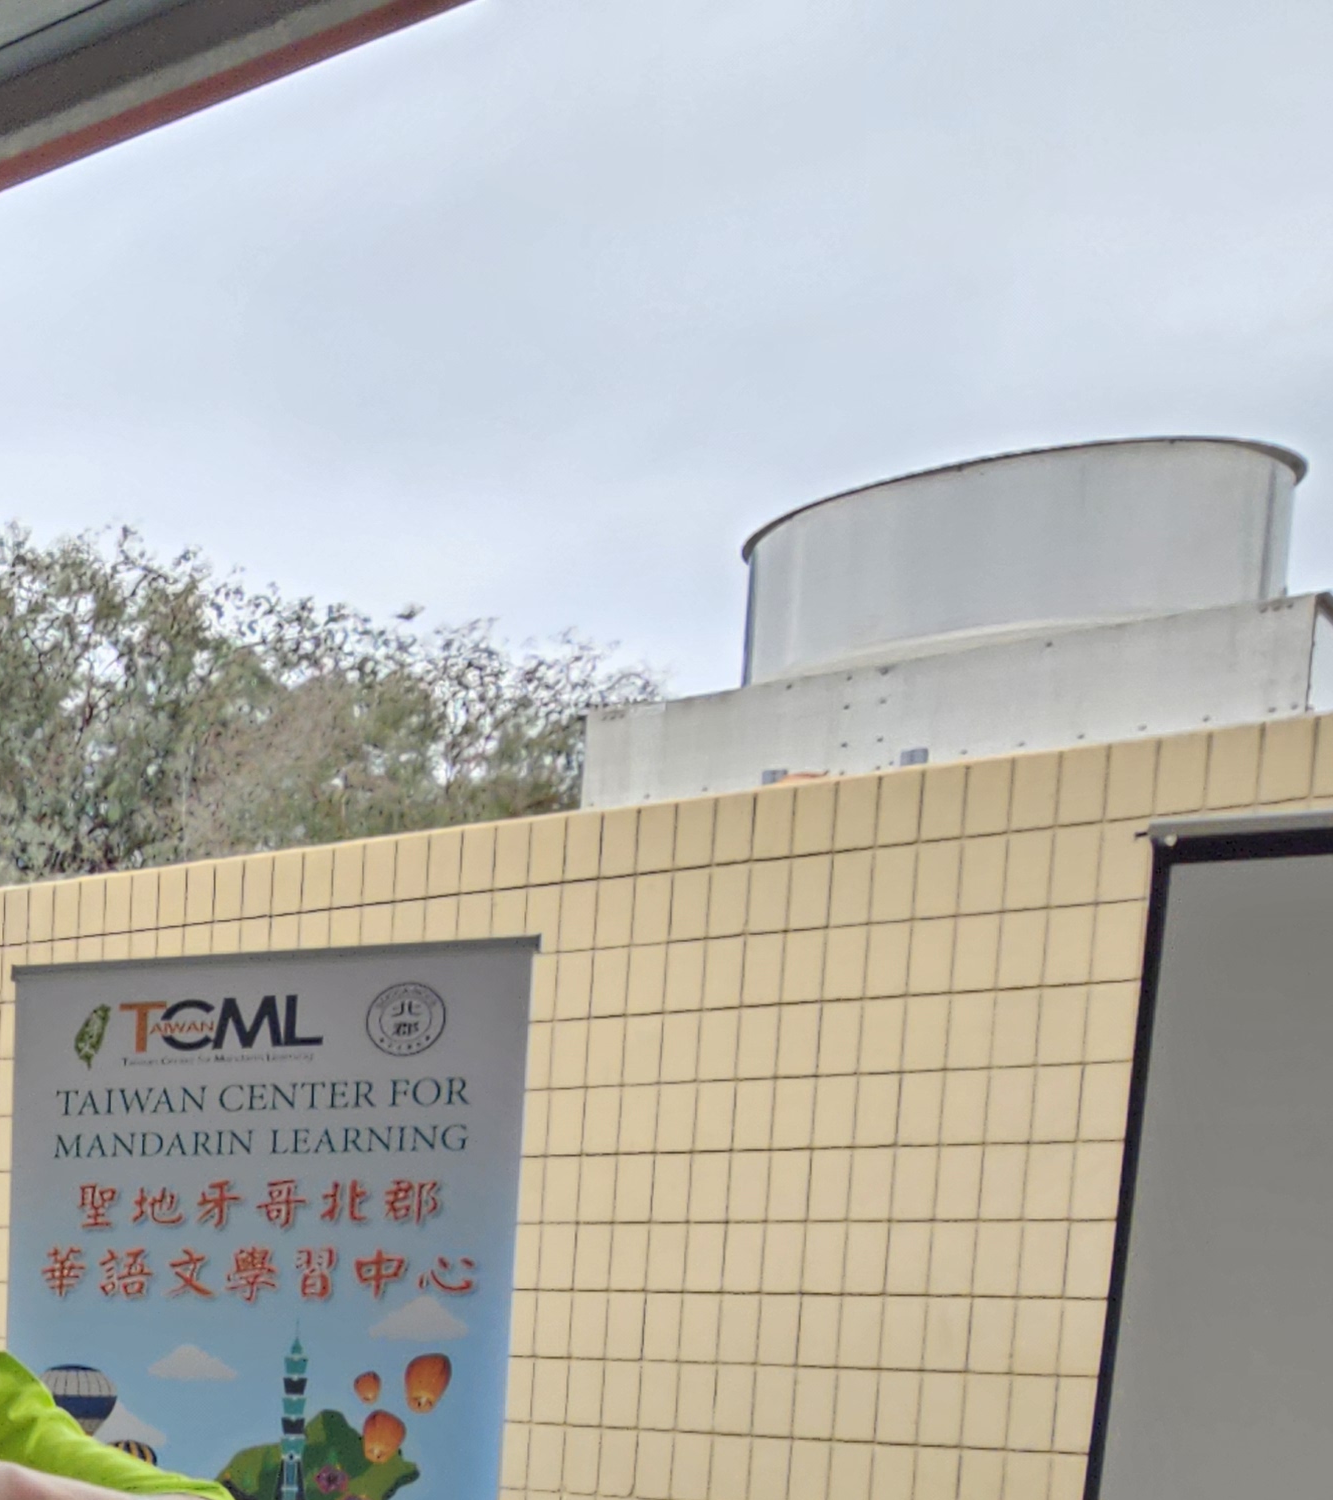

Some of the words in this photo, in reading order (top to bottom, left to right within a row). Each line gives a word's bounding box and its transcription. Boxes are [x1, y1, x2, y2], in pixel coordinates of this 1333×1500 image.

[56, 1085, 206, 1117] TAIWAN
[218, 1077, 376, 1112] CENTER
[389, 1077, 472, 1107] FOR
[53, 1129, 253, 1160] MANDARIN
[270, 1124, 469, 1156] LEARNING
[78, 1179, 440, 1230] 聖地牙哥北郡
[41, 1246, 477, 1302] 華語文學習中心
